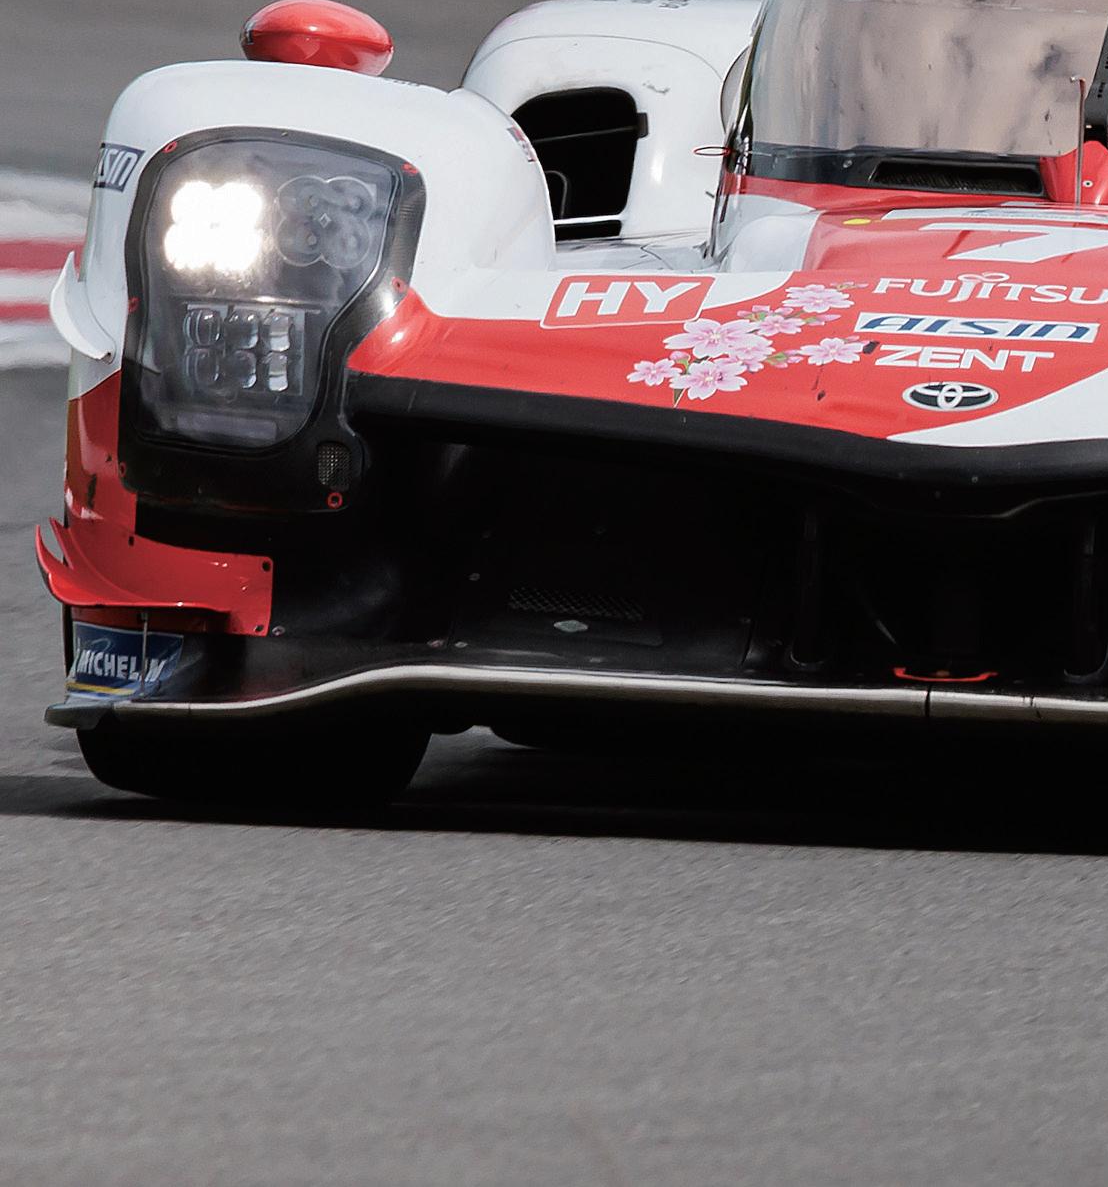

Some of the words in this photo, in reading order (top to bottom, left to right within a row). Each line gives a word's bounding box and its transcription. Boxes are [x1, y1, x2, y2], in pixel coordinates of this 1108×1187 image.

[556, 280, 701, 318] HY
[859, 315, 1092, 340] AISIN
[874, 344, 1055, 373] ZENT
